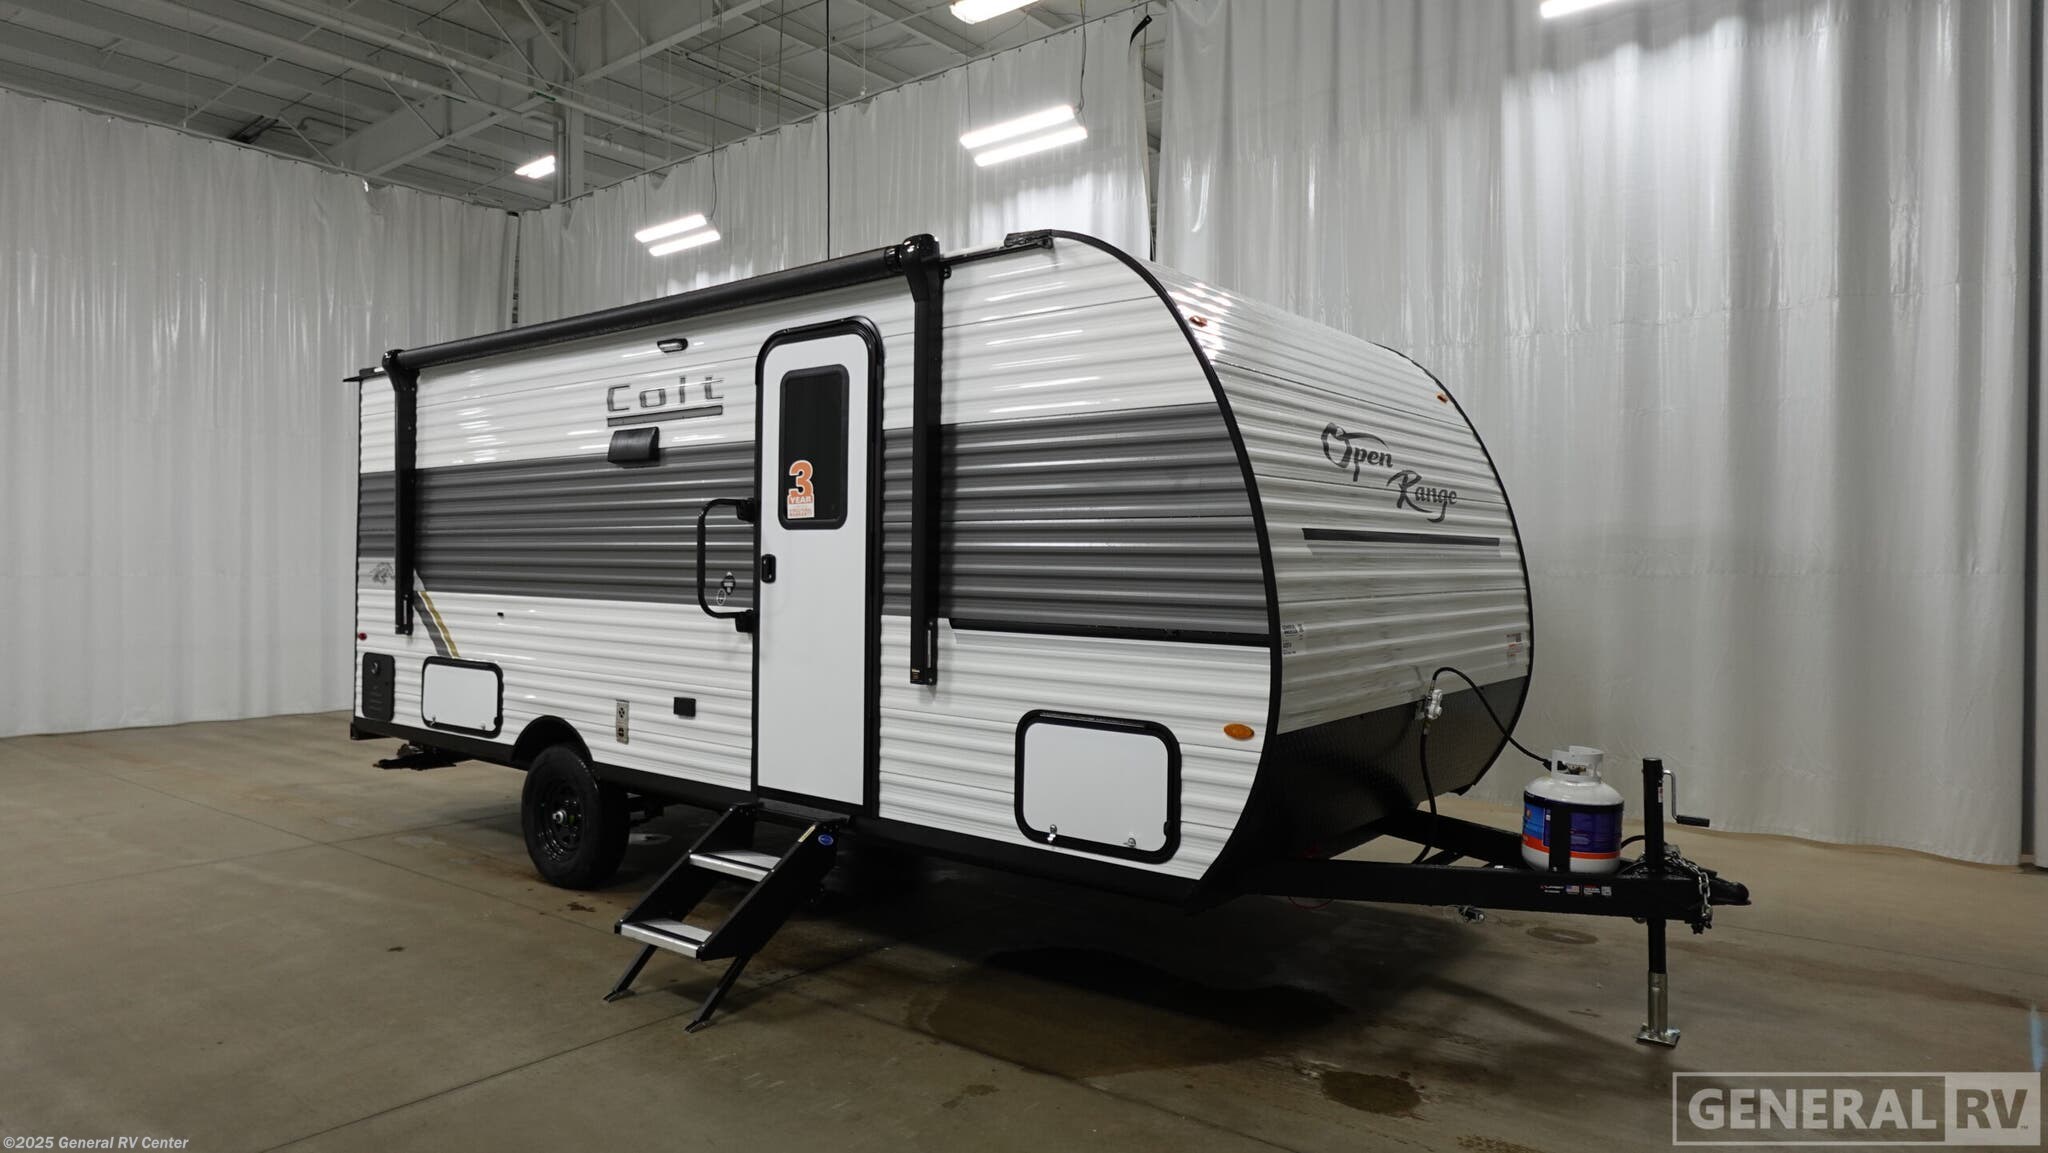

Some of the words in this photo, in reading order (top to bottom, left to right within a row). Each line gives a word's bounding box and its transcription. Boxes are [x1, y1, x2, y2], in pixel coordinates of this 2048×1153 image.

[607, 375, 725, 412] Colt
[1320, 422, 1393, 482] Open
[788, 459, 813, 496] 3
[1386, 469, 1457, 523] Range
[790, 495, 812, 504] YEAR
